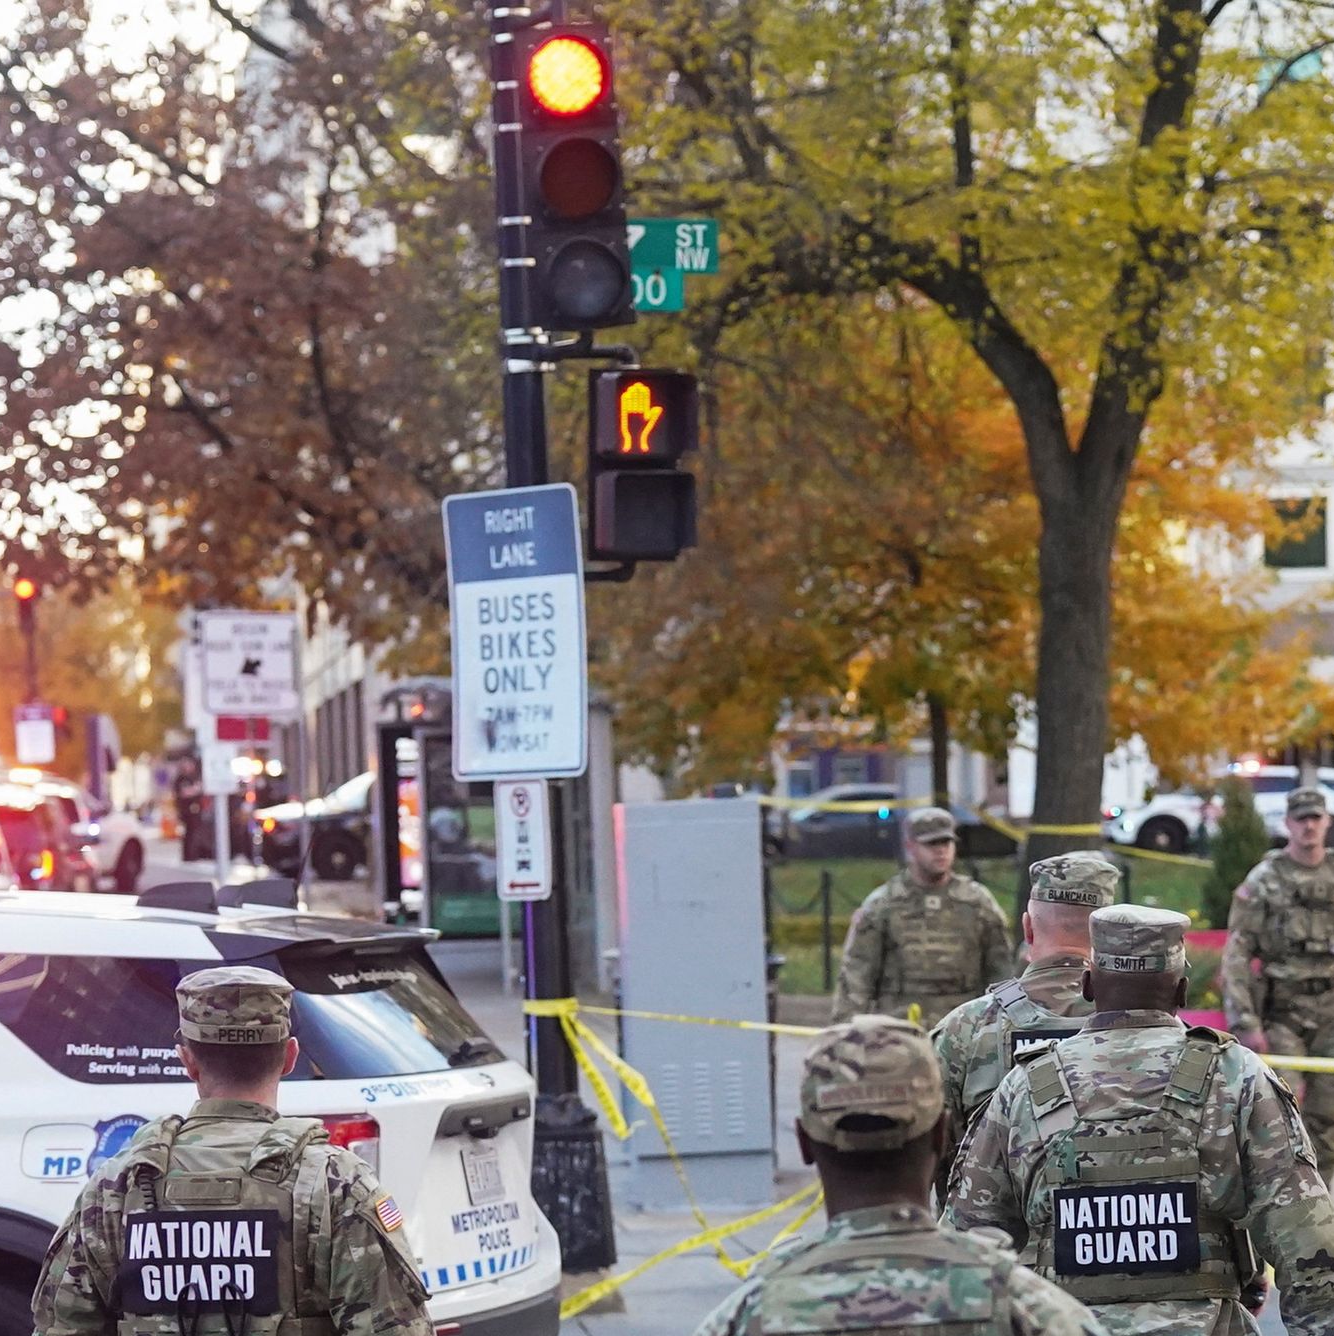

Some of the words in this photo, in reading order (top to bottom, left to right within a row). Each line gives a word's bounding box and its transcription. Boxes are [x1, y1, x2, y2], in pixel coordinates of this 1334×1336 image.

[675, 223, 708, 247] ST
[675, 247, 710, 271] NW
[484, 506, 535, 534] RIGHT
[490, 542, 538, 569] LANE
[479, 592, 555, 625] BUSES
[480, 629, 556, 662] BIKES
[484, 663, 554, 694] ONLY
[1048, 889, 1097, 904] BLANCHARD
[1114, 958, 1147, 970] SMITH
[219, 1029, 265, 1042] PERRY
[66, 1043, 115, 1059] Policing
[116, 1046, 139, 1057] with
[141, 1047, 179, 1060] purpo
[89, 1062, 136, 1077] Serving
[138, 1063, 161, 1074] with
[43, 1157, 82, 1176] MP
[451, 1202, 520, 1234] METROPOLITAN
[1059, 1193, 1192, 1229] NATIONAL
[129, 1221, 271, 1260] NATIONAL
[478, 1228, 512, 1252] POLICE
[1075, 1229, 1178, 1265] GUARD
[141, 1264, 255, 1301] GUARD
